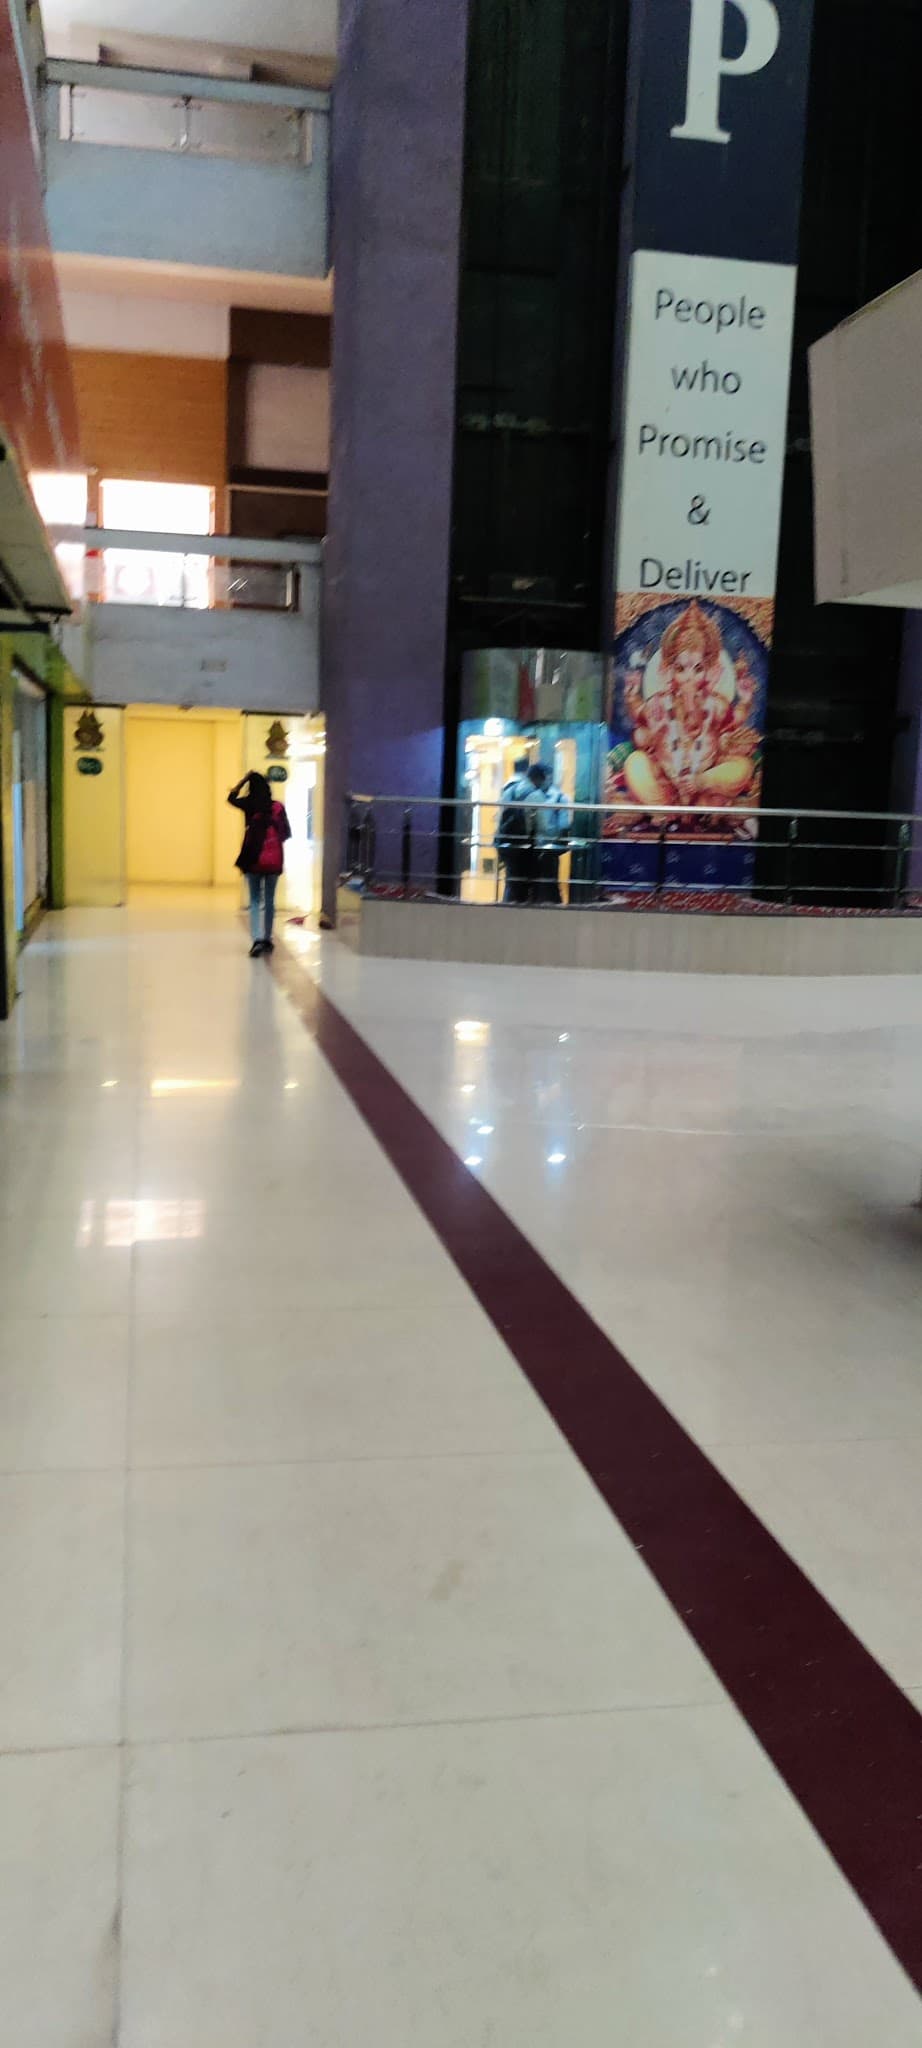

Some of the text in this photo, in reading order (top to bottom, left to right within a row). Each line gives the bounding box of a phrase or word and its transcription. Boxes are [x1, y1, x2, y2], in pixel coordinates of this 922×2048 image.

[670, 0, 780, 144] P
[655, 288, 766, 334] People
[671, 360, 741, 395] who
[639, 424, 767, 464] Promise
[687, 495, 711, 525] &
[640, 558, 752, 593] Deliver
